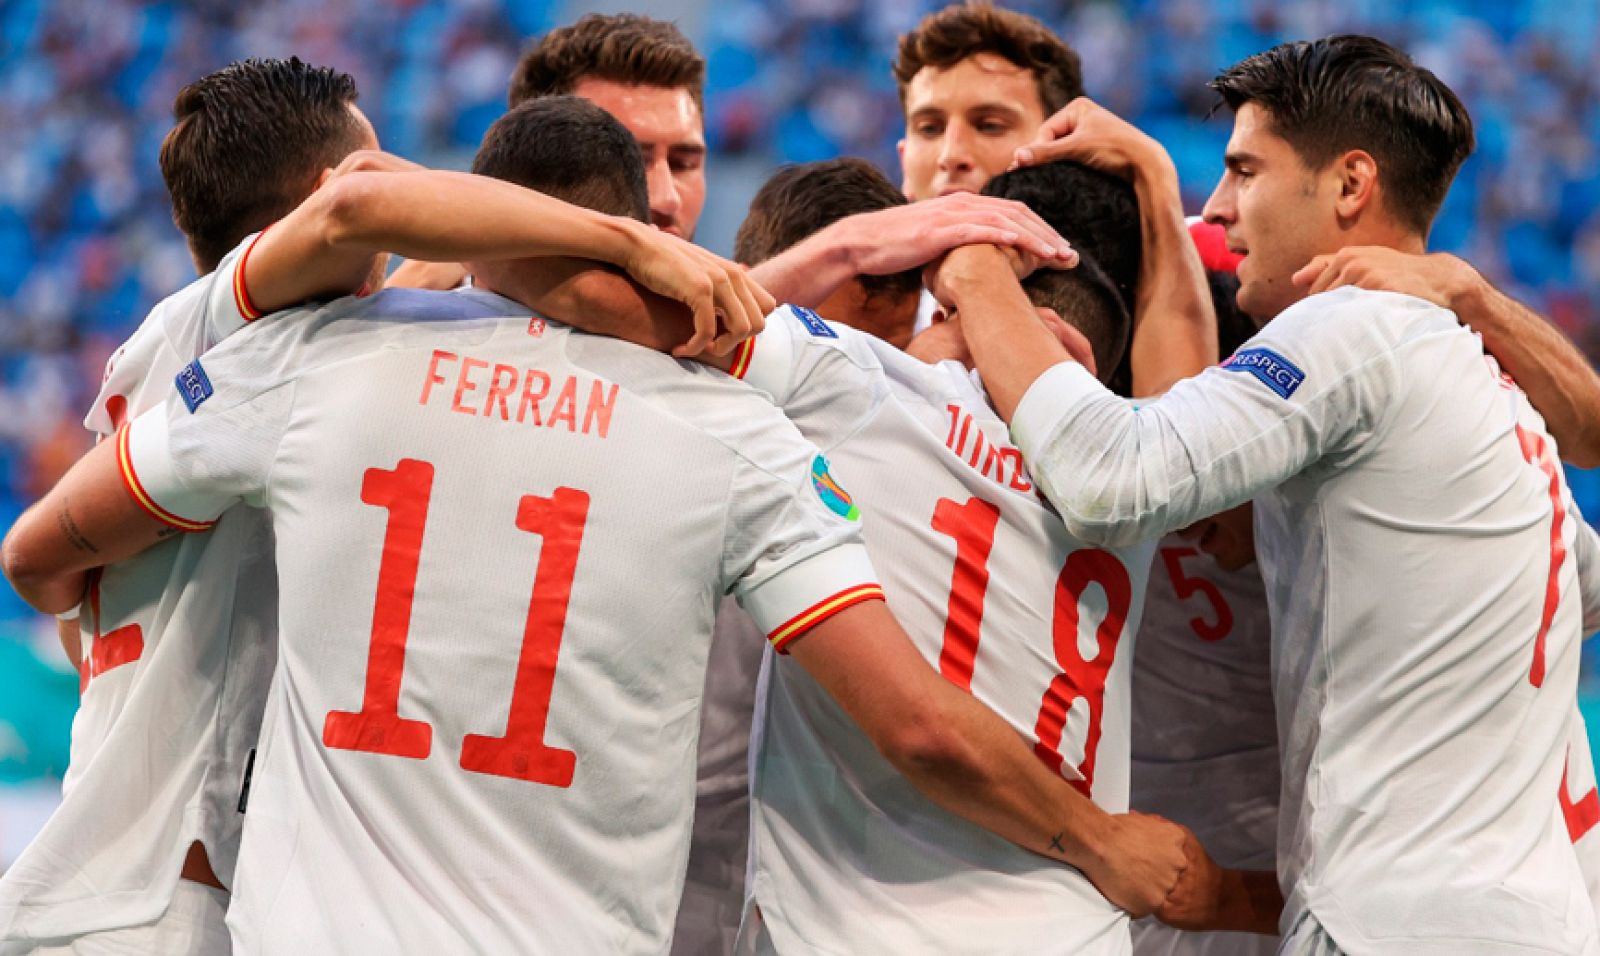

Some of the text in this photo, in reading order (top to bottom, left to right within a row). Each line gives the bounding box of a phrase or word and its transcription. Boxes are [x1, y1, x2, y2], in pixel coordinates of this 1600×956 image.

[419, 349, 619, 438] FERRAN
[1232, 353, 1300, 389] RESPECT
[323, 458, 590, 788] 11
[1160, 547, 1233, 642] 5
[931, 496, 1132, 799] 18
